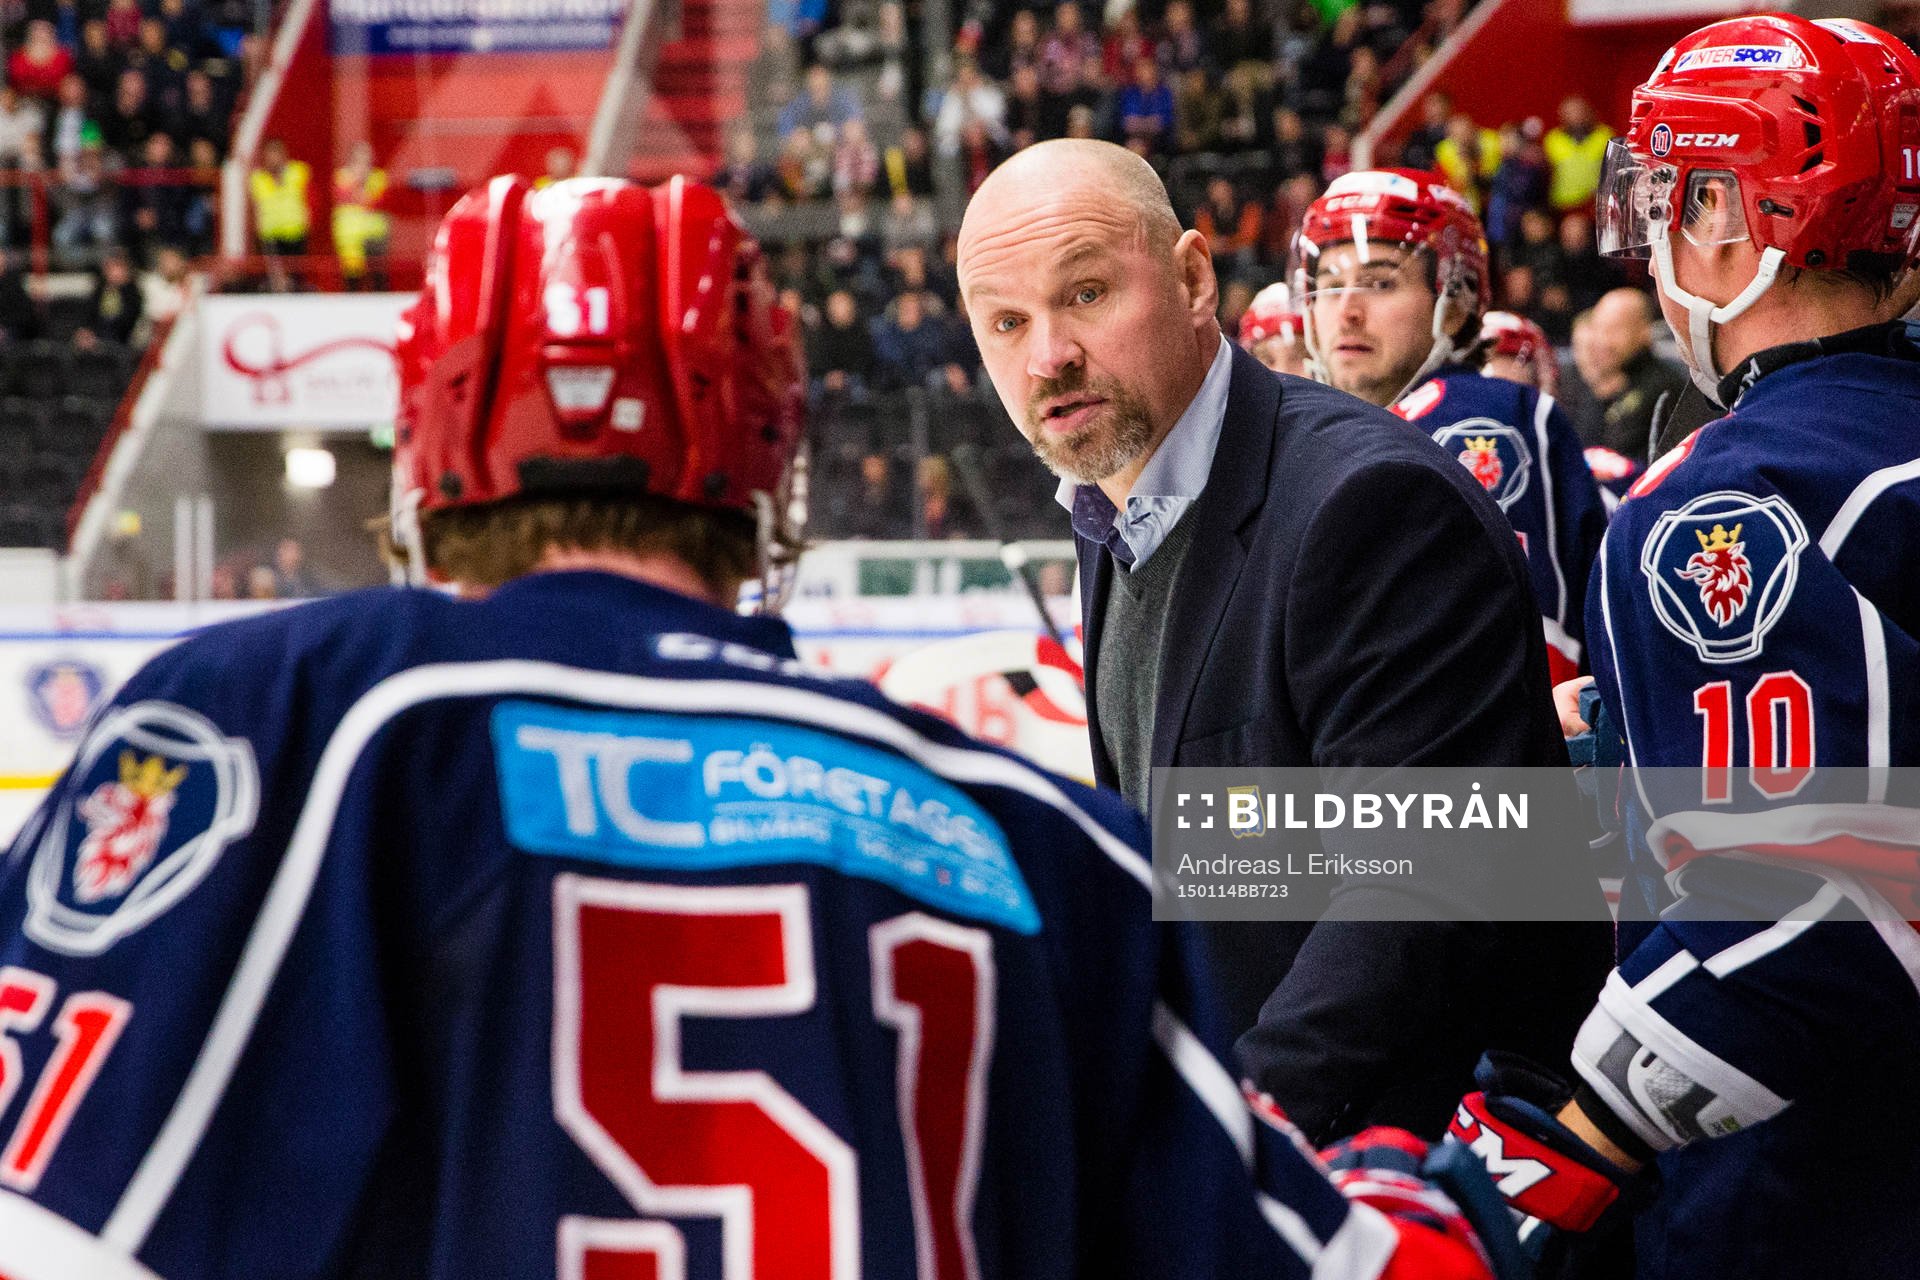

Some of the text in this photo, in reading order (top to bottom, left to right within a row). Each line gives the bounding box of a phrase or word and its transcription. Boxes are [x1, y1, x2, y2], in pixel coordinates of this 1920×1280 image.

[1690, 48, 1783, 65] INTERSPORT
[1654, 130, 1669, 152] 11
[1674, 133, 1741, 147] CCM
[1693, 669, 1817, 806] 10
[515, 723, 706, 849] TC
[551, 871, 999, 1280] 51
